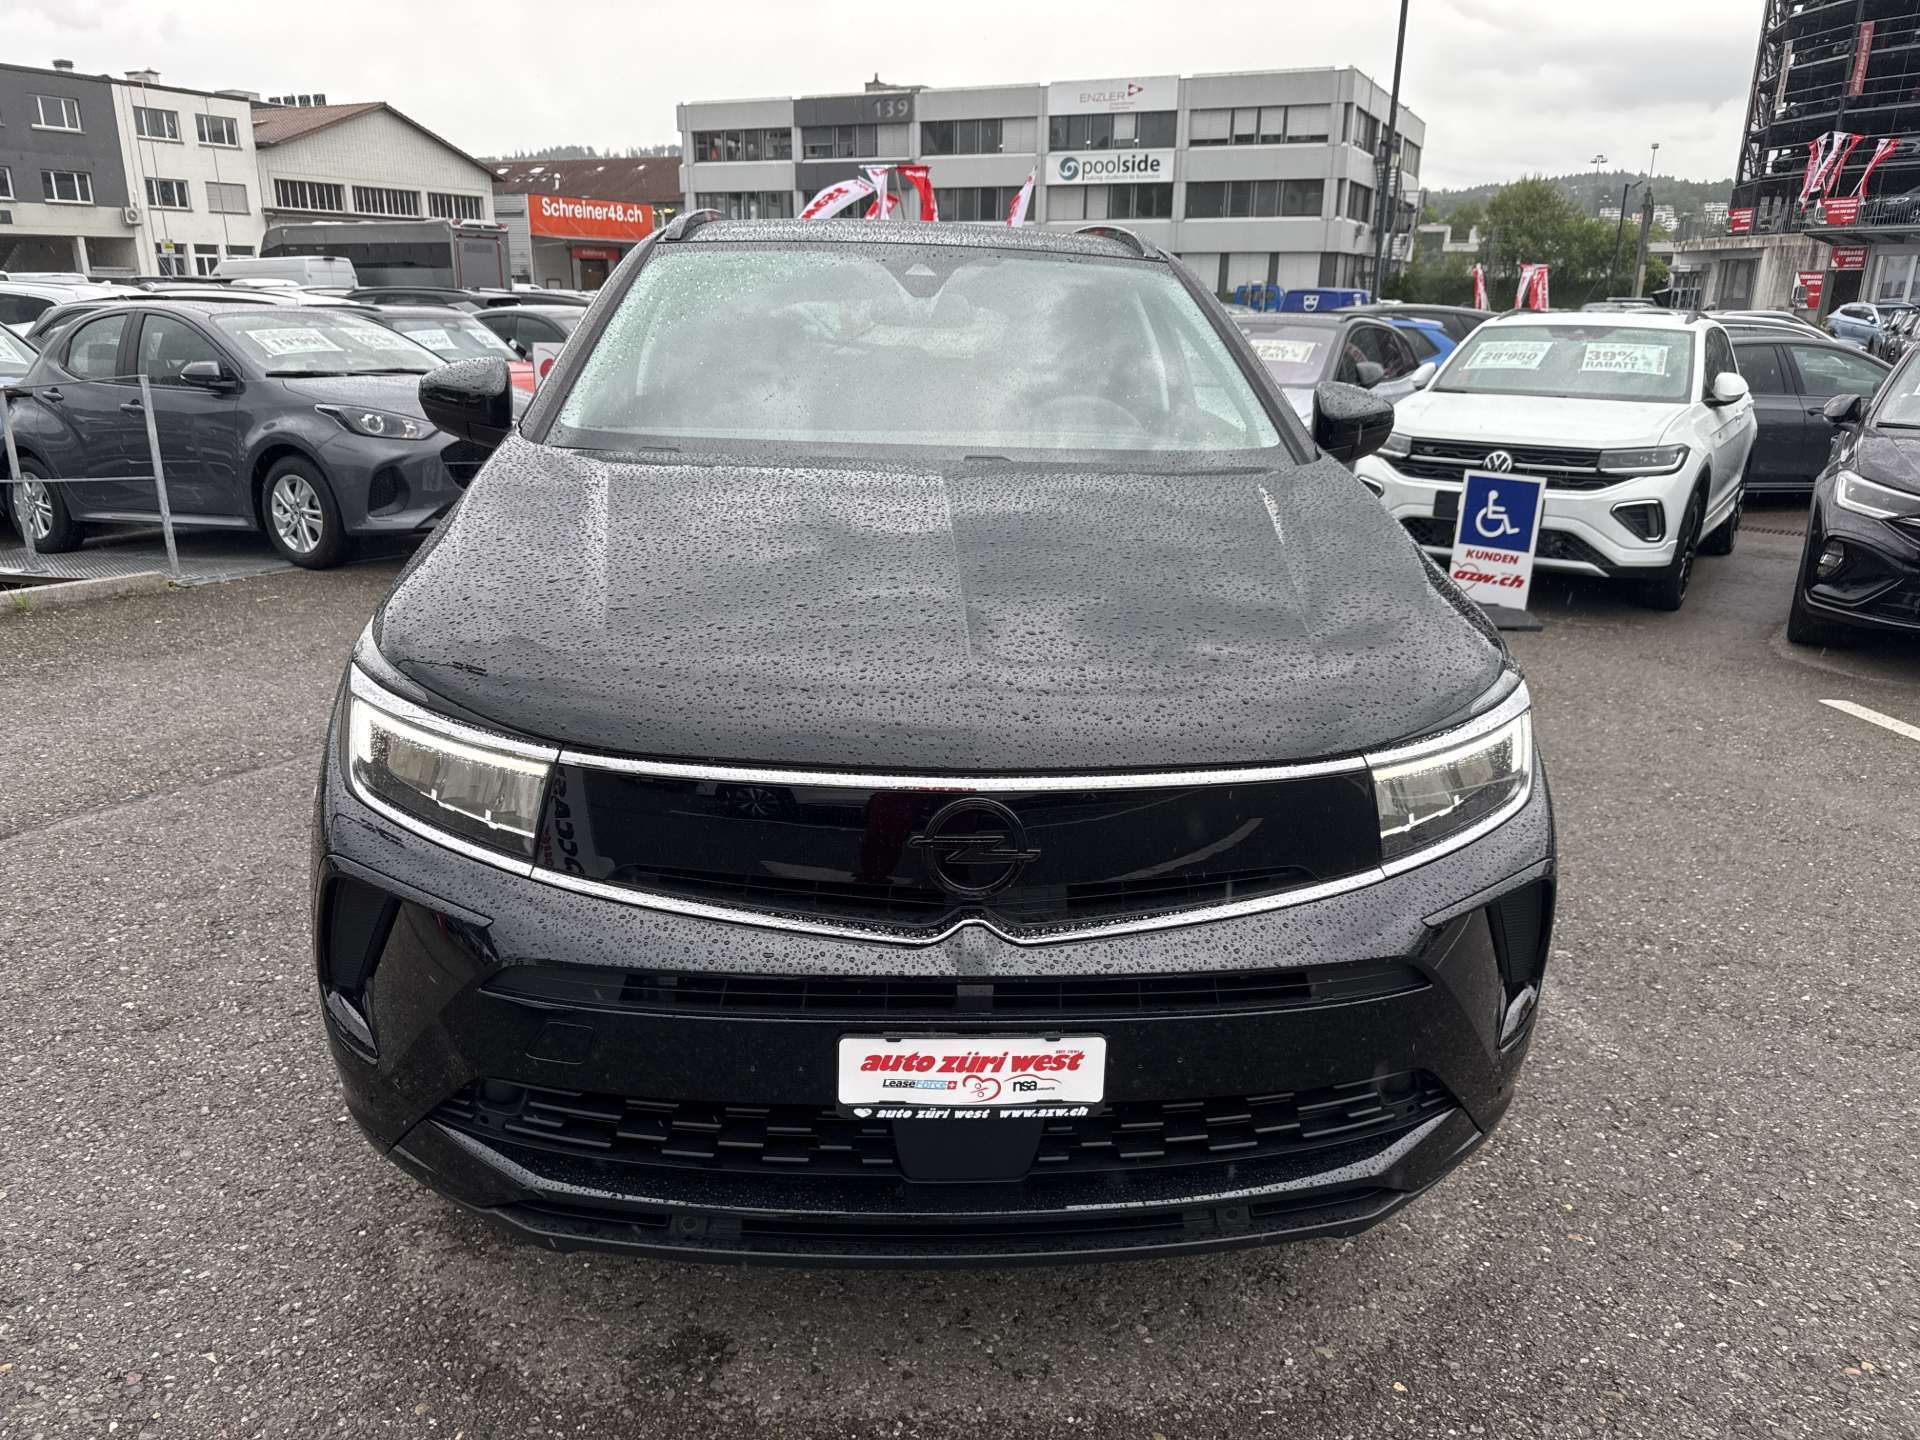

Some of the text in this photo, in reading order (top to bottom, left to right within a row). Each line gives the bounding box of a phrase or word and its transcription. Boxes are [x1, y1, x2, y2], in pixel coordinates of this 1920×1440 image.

[1079, 91, 1126, 103] ENZLER
[873, 99, 909, 118] 139
[1081, 153, 1161, 181] poolside
[541, 196, 643, 224] Schreiner48.ch
[1587, 350, 1639, 362] 39%
[1585, 361, 1638, 369] RABATT
[1465, 549, 1520, 565] KUNDEN
[1453, 569, 1525, 589] azw.ch
[860, 1051, 1086, 1073] auto züri west
[1012, 1080, 1037, 1092] nsa
[876, 1106, 1089, 1119] auto züri west www.azw.ch
